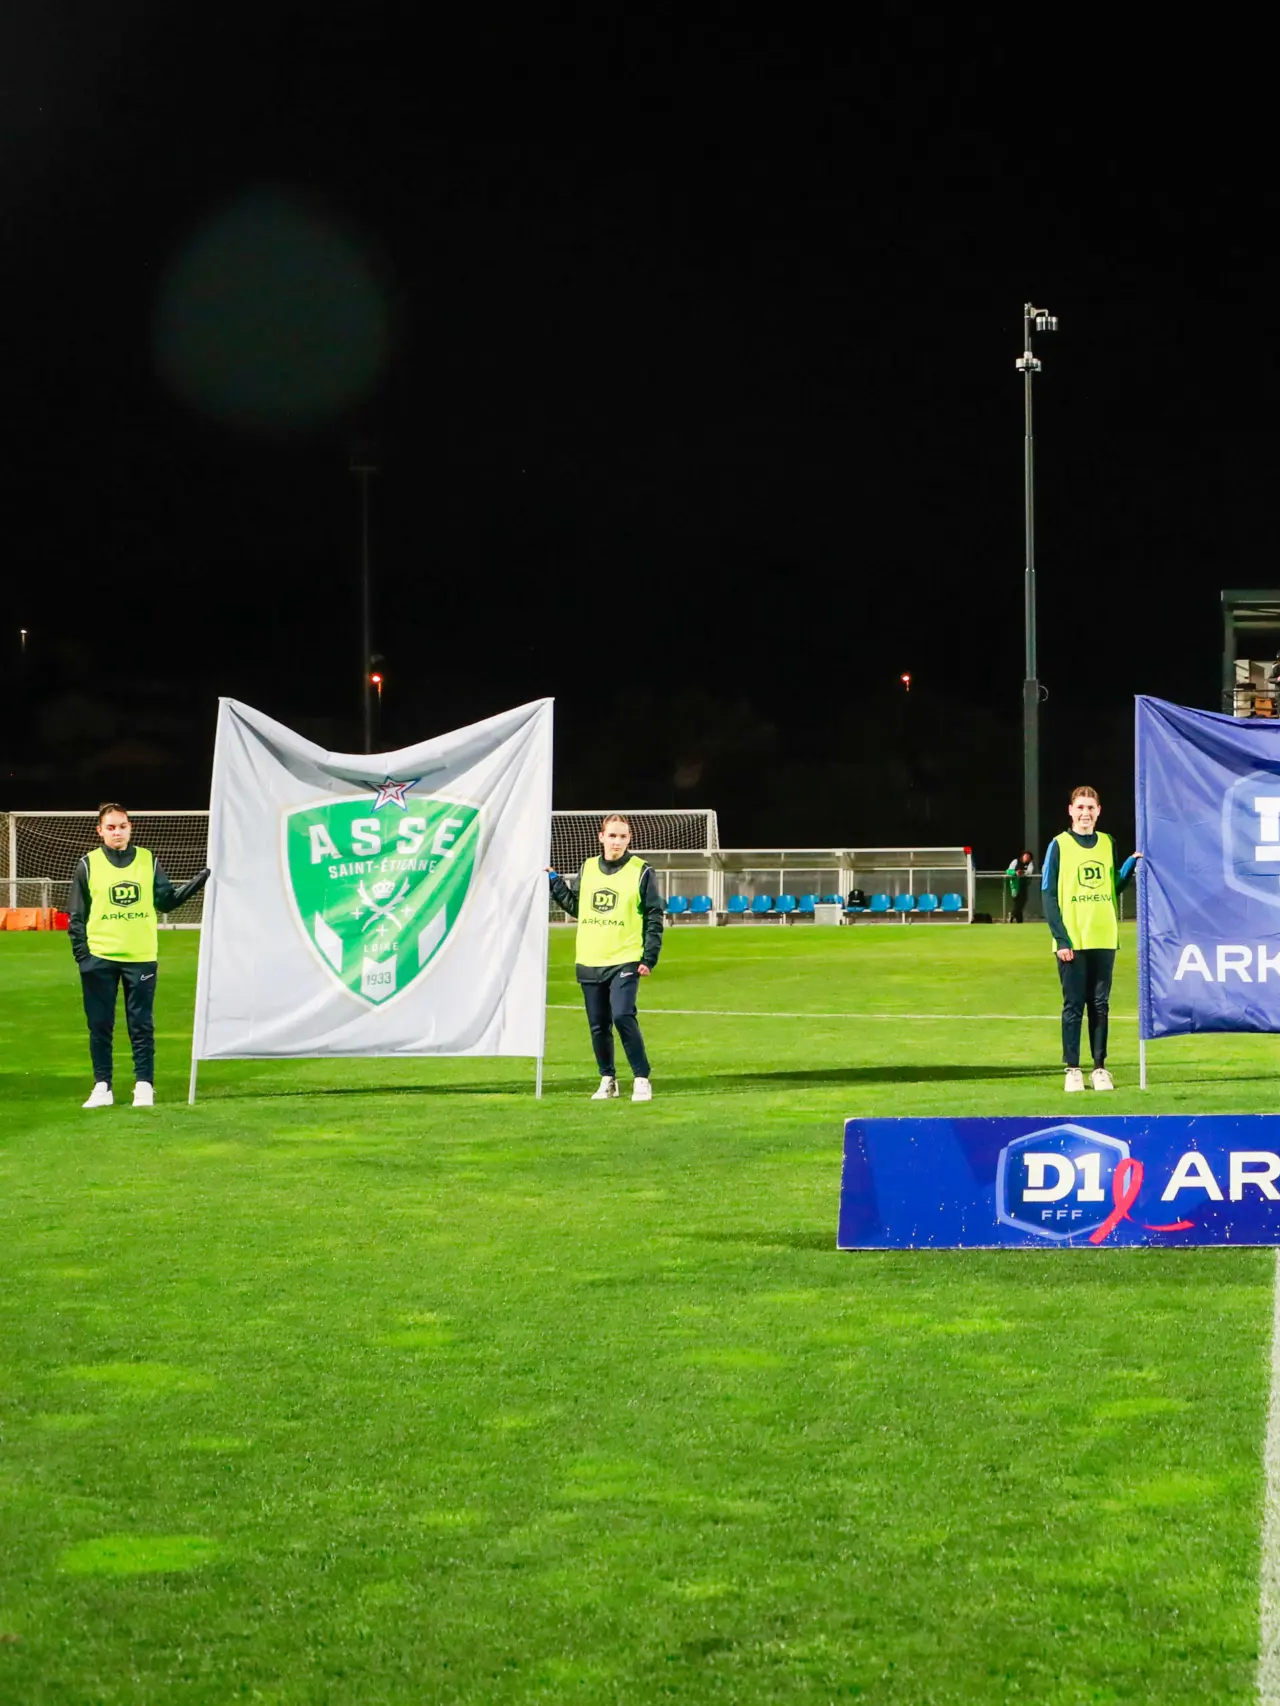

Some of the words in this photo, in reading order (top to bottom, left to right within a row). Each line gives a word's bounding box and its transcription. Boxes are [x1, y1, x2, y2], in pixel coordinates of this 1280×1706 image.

[308, 817, 464, 865] ASSE
[1083, 867, 1102, 880] D1
[114, 886, 137, 900] D1
[594, 893, 614, 907] D1
[366, 971, 392, 986] 1933
[1022, 1152, 1105, 1203] D1
[1041, 1209, 1083, 1221] FFF
